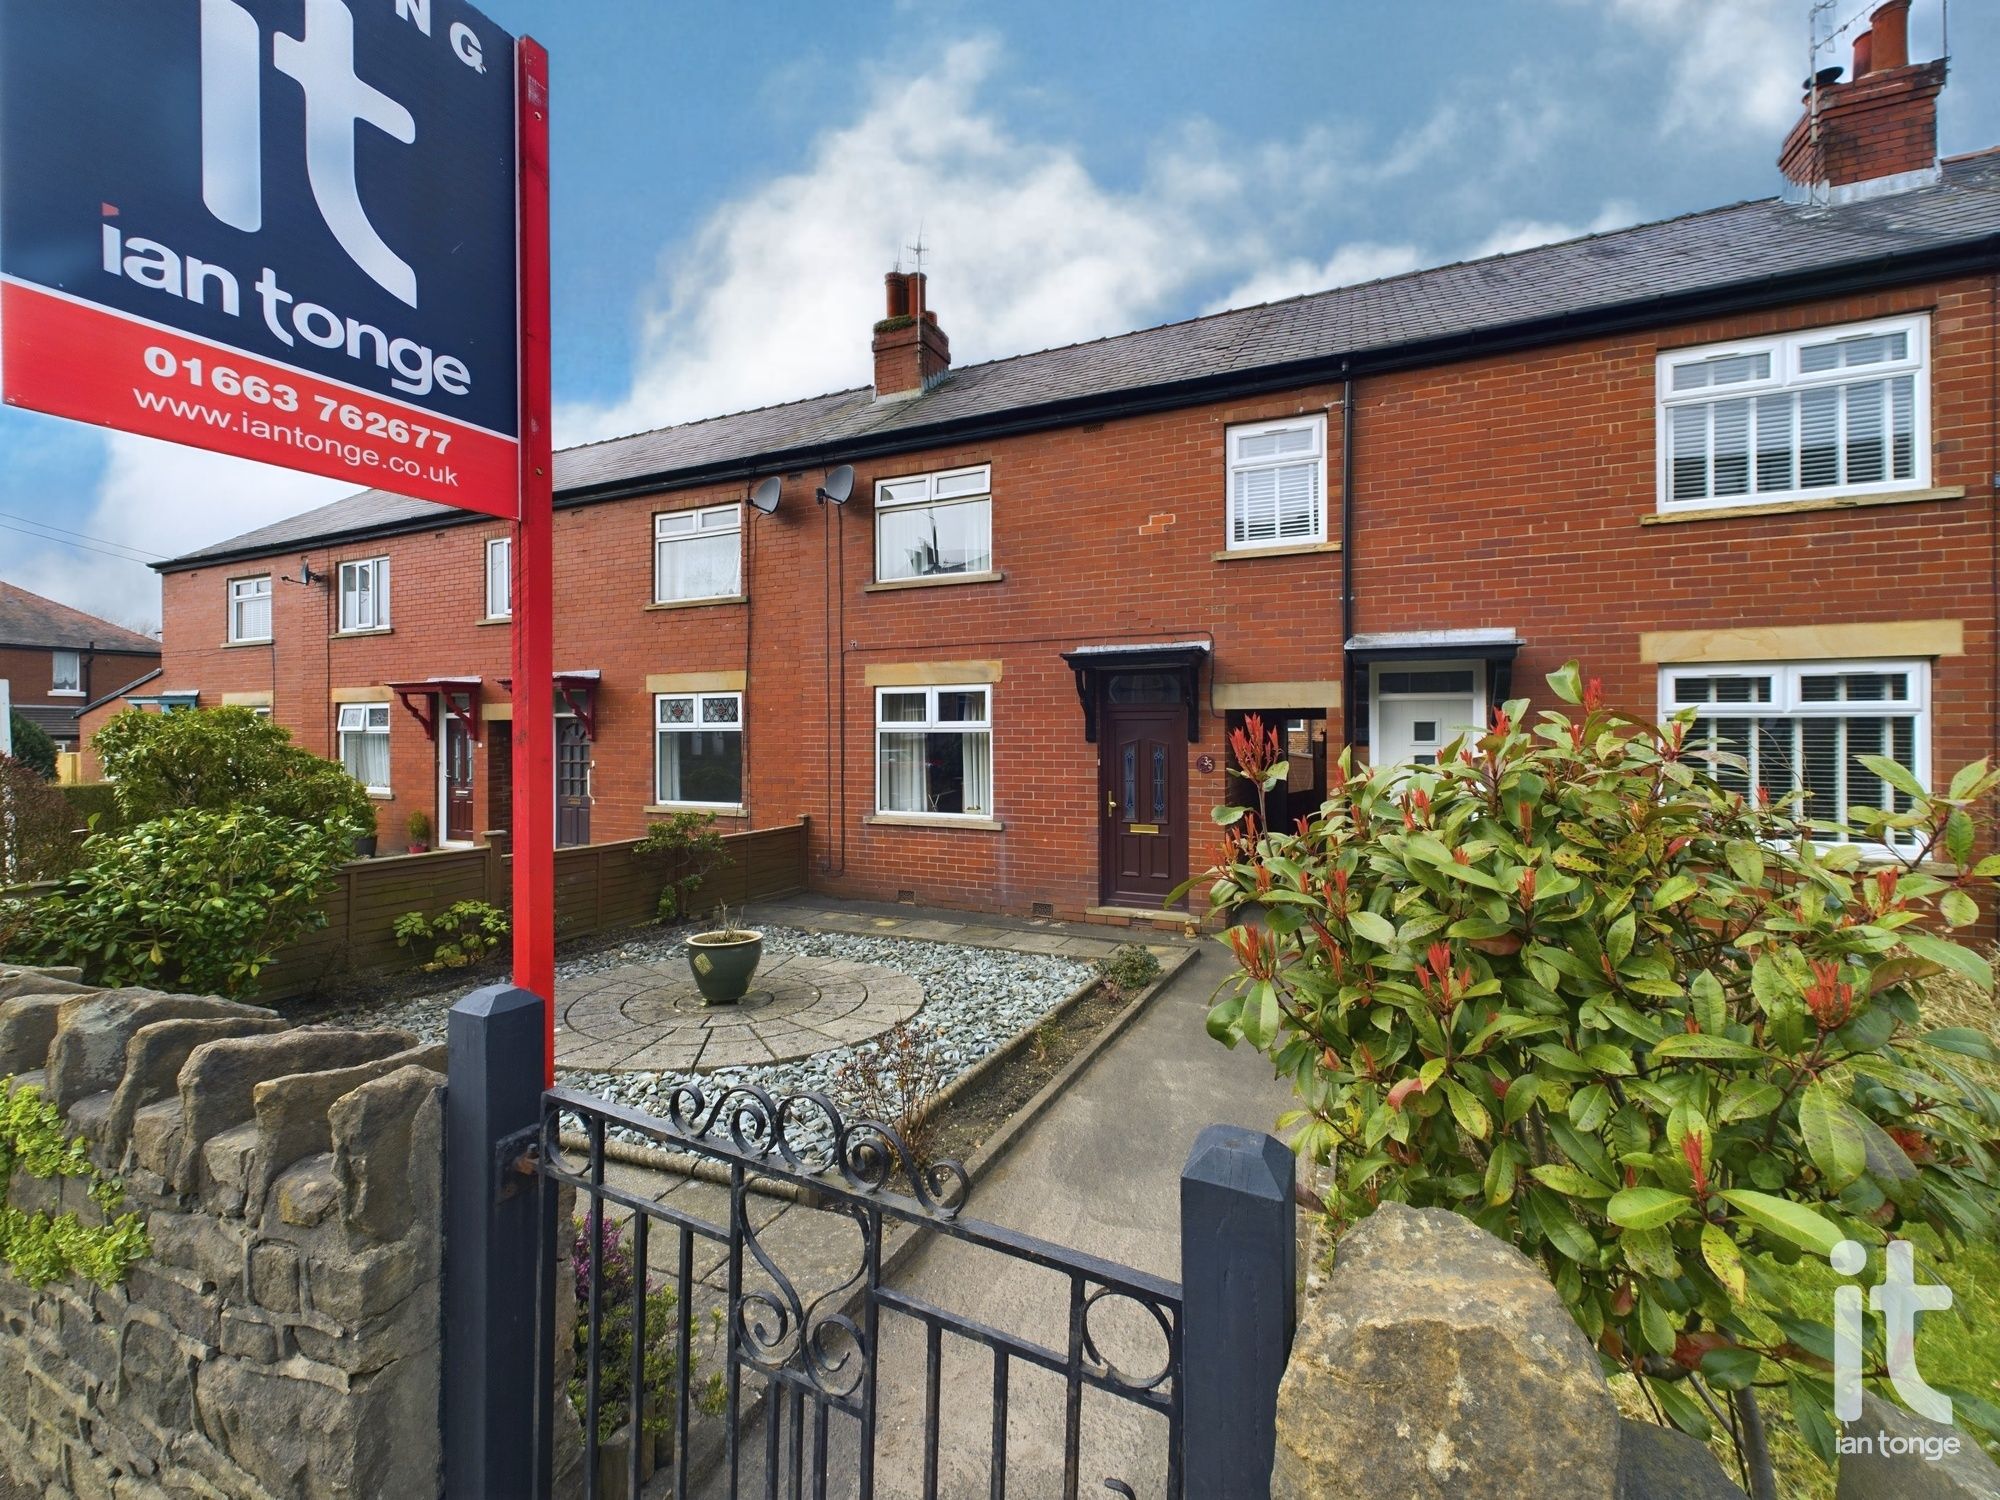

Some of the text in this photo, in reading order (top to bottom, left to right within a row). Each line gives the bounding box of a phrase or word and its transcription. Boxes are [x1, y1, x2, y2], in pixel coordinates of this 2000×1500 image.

[102, 202, 471, 396] ian tonge
[132, 387, 459, 487] www.iantonge.co.uk
[143, 346, 452, 456] 01663 762677
